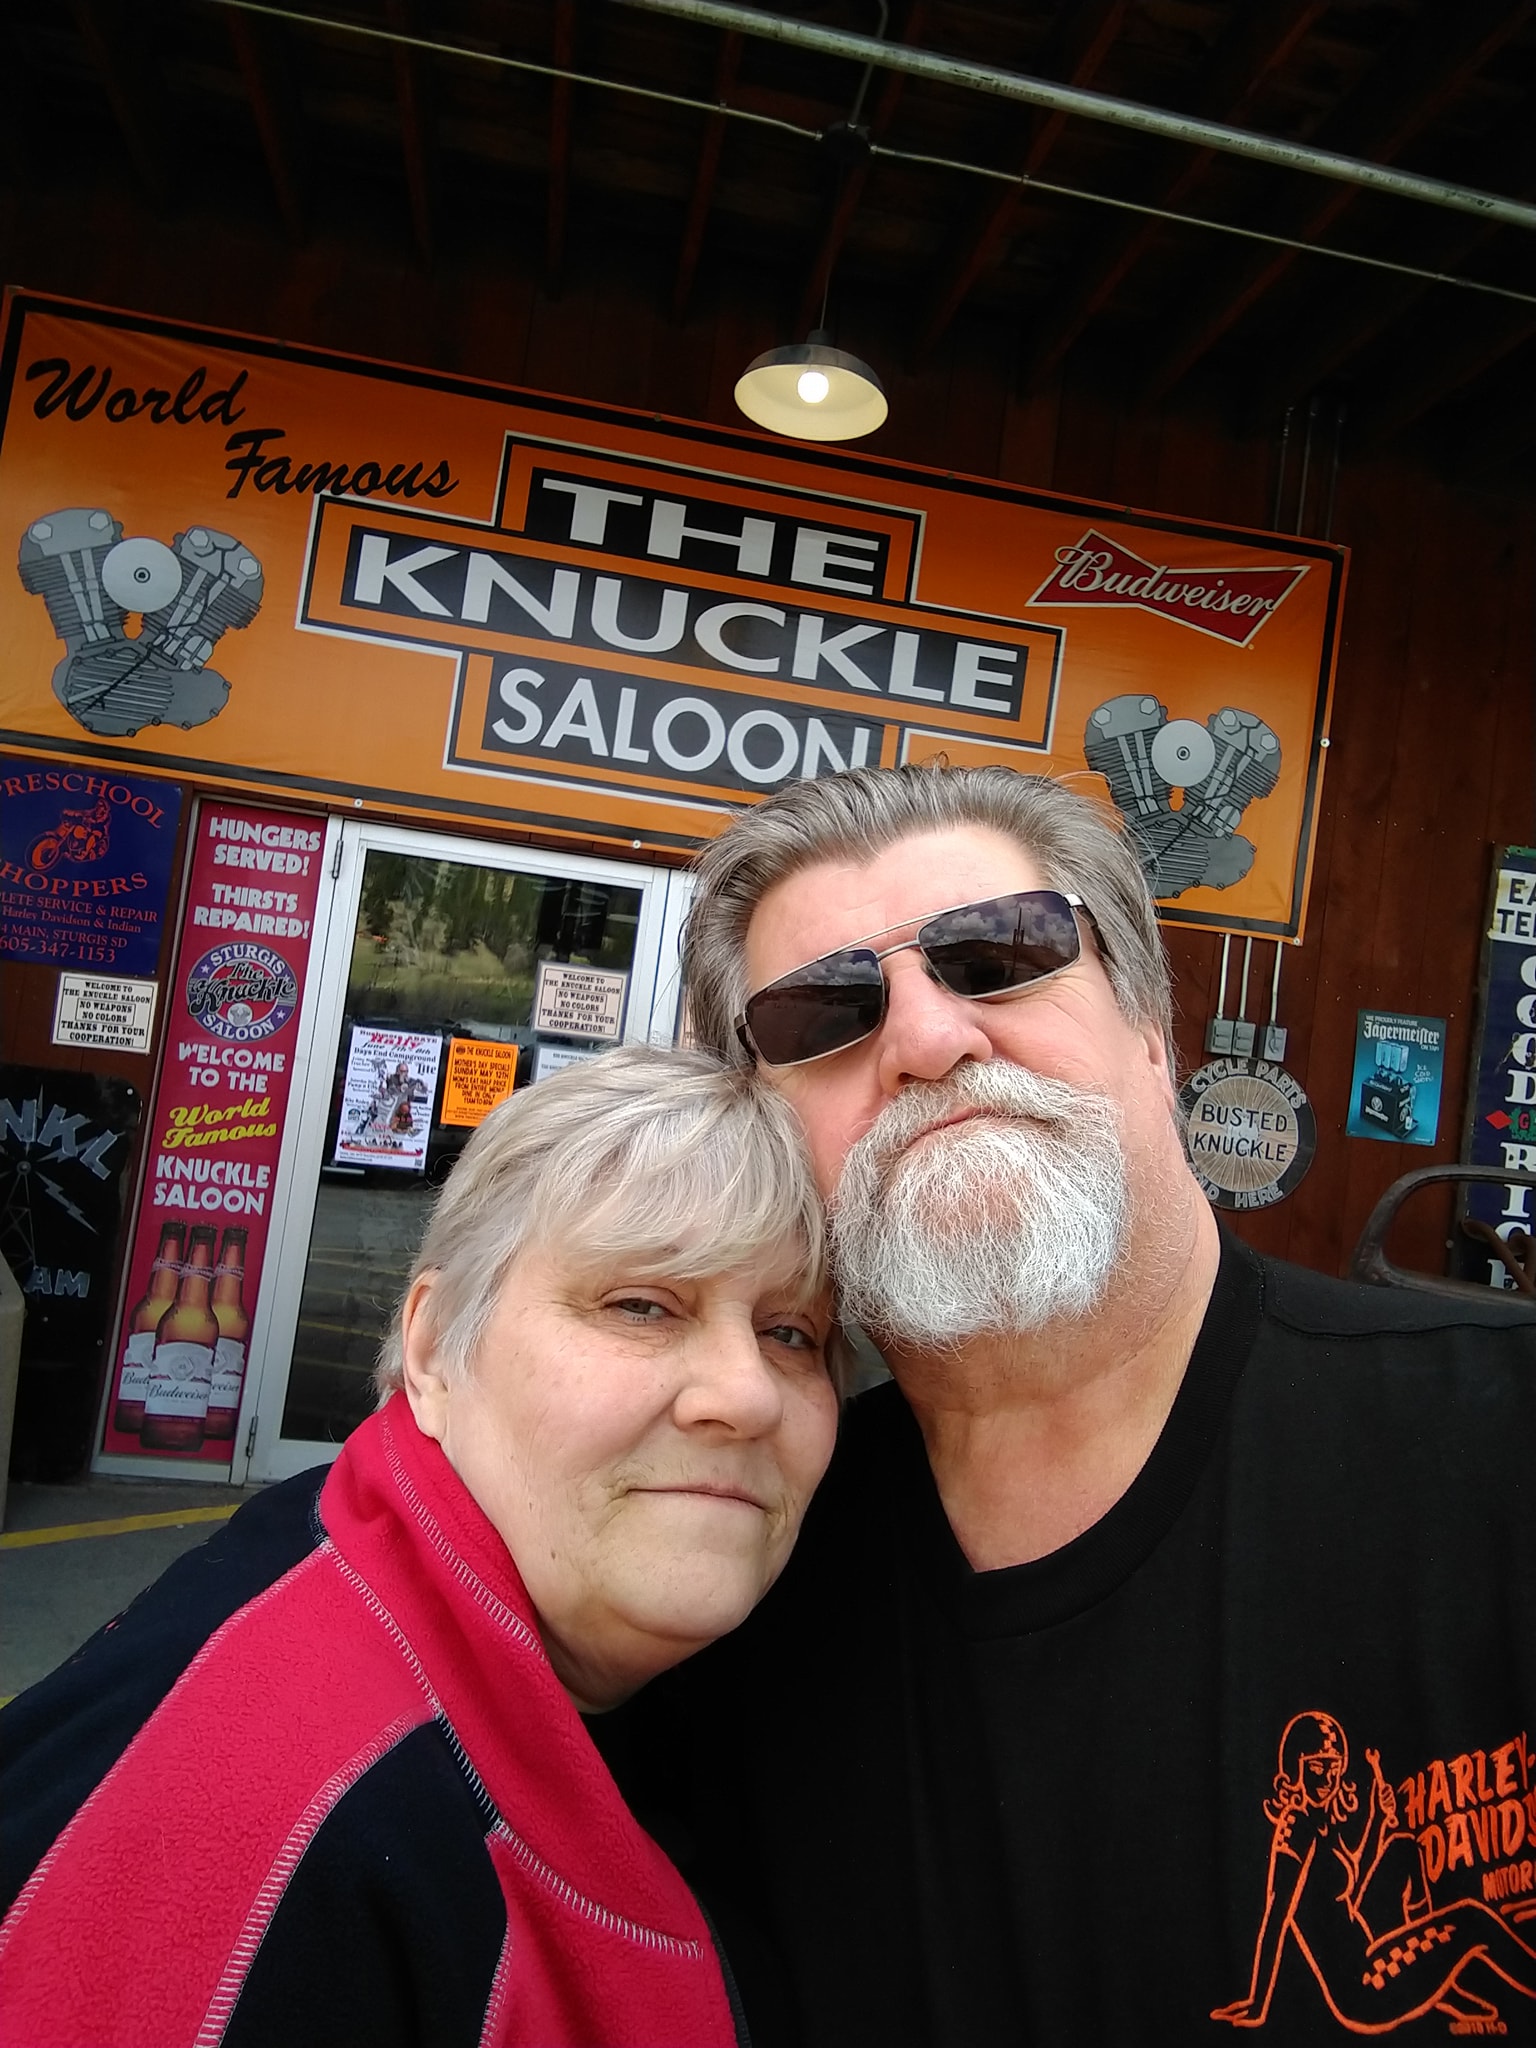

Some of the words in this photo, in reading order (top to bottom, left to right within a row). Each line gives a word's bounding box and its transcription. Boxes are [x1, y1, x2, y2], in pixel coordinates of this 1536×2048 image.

[26, 358, 249, 425] World
[225, 429, 459, 499] Famous
[542, 477, 880, 596] THE
[1054, 545, 1273, 617] Budweiser
[354, 534, 1018, 713] KNUCKLE
[492, 668, 869, 784] SALOON
[0, 772, 165, 829] RESCHOOL
[209, 817, 320, 852] HUNGERS
[214, 844, 310, 876] SERVED!
[0, 892, 33, 907] LETE
[37, 896, 92, 914] SERVICE
[96, 905, 106, 916] &
[111, 906, 158, 923] REPAIR
[212, 883, 298, 912] THIRSTS
[2, 905, 37, 920] Harley
[41, 910, 90, 927] Davidson
[94, 918, 104, 929] &
[108, 919, 141, 933] Indian
[194, 906, 310, 939] REPAIRED!
[0, 936, 115, 963] 605-347-1153
[53, 929, 108, 947] STURGIS
[111, 937, 127, 949] SD
[211, 944, 285, 974] STURGIS
[225, 960, 264, 980] The
[85, 981, 121, 992] WELCOME
[123, 985, 133, 993] TO
[561, 981, 592, 991] KNUCKLE
[594, 986, 620, 994] SALOON
[563, 973, 594, 983] WELCOME
[596, 977, 605, 985] TO
[64, 988, 80, 996] THE
[83, 990, 118, 1000] KNUCKLE
[121, 994, 150, 1004] SALOON
[80, 1001, 91, 1009] NO
[94, 1002, 132, 1013] WEAPONS
[189, 976, 296, 1015] Knuckle
[570, 992, 604, 1003] WEAPONS
[572, 1002, 600, 1012] COLORS
[61, 1020, 97, 1031] THANKS
[101, 1024, 119, 1034] FOR
[122, 1027, 145, 1036] YOUR
[82, 1011, 94, 1020] NO
[96, 1013, 127, 1023] COLORS
[203, 1014, 275, 1040] SALOON
[542, 1009, 574, 1019] THANKS
[577, 1013, 593, 1021] FOR
[595, 1015, 615, 1024] YOUR
[549, 1020, 606, 1032] COOPERATION!
[69, 1032, 134, 1047] COOPERATION!
[1364, 1021, 1440, 1045] Jägermeister
[179, 1042, 285, 1073] WELCOME
[354, 1047, 372, 1057] Days
[374, 1049, 388, 1057] End
[389, 1051, 437, 1063] Campground
[189, 1066, 220, 1089] TO
[227, 1070, 268, 1093] THE
[454, 1067, 477, 1075] SUNDAY
[480, 1069, 492, 1078] MAY
[1191, 1058, 1249, 1093] CYCLE
[1255, 1060, 1307, 1109] PARTS
[169, 1097, 270, 1127] World
[1201, 1103, 1288, 1132] BUSTED
[162, 1121, 277, 1149] Famous
[1193, 1132, 1287, 1162] KNUCKLE
[155, 1155, 271, 1191] KNUCKLE
[153, 1182, 265, 1216] SALOON
[1235, 1183, 1283, 1208] HERE
[149, 1383, 209, 1400] Budweiser
